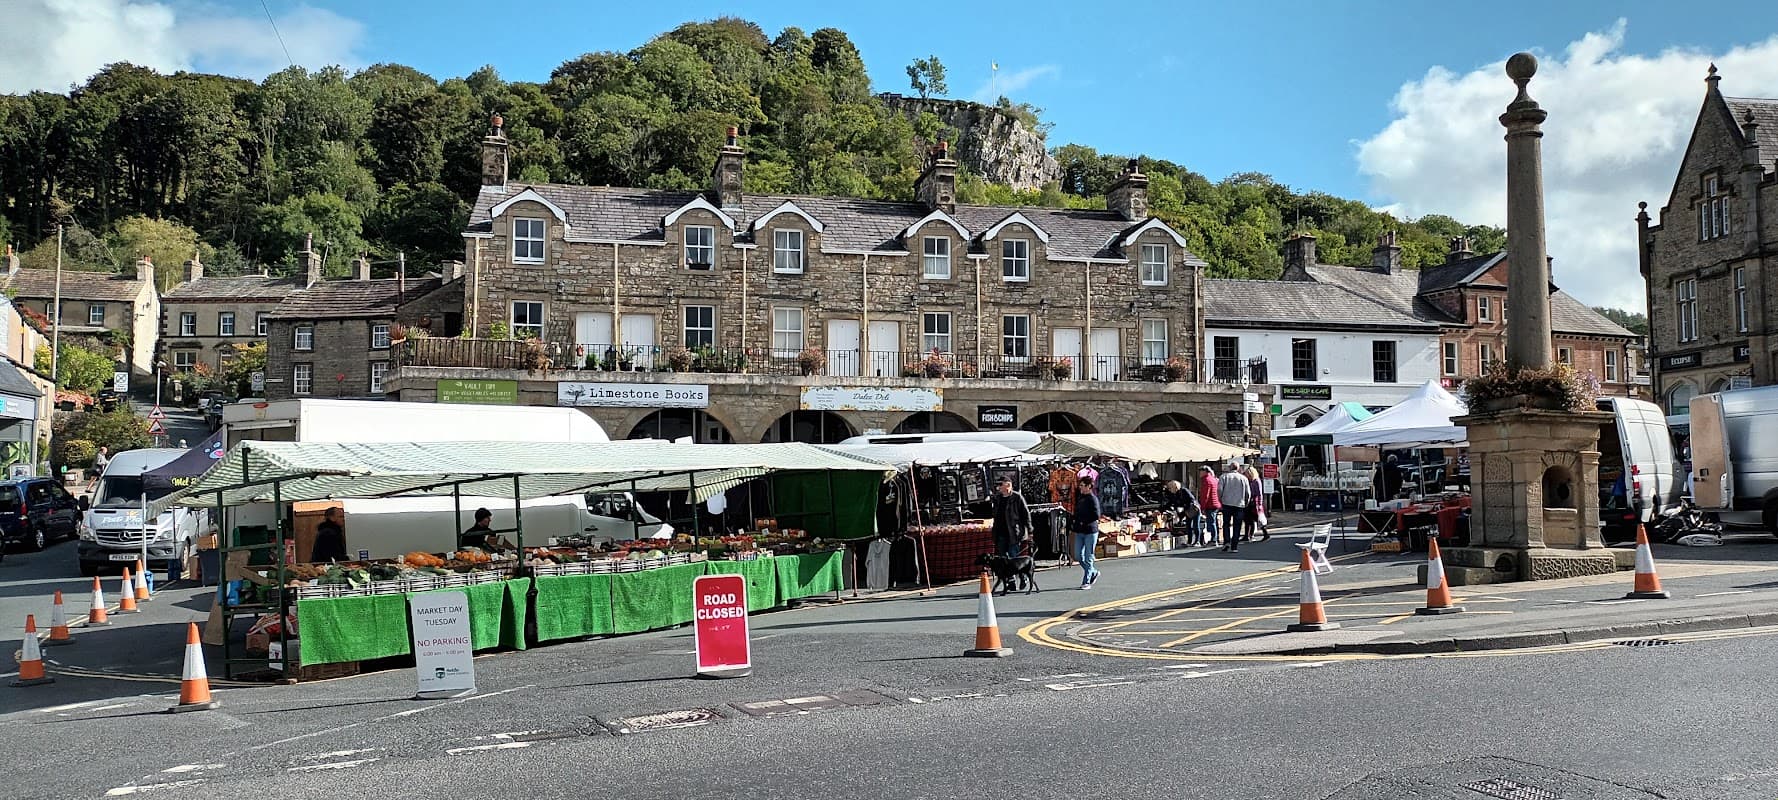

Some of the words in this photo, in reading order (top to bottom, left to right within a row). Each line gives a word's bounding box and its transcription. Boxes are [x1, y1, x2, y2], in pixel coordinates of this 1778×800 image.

[589, 387, 659, 399] Limestone
[665, 389, 704, 400] Books
[704, 594, 735, 605] ROAD
[417, 606, 447, 615] MARKET
[698, 607, 743, 619] CLOSED
[425, 618, 456, 626] TUESDAY
[433, 637, 468, 646] PARKING
